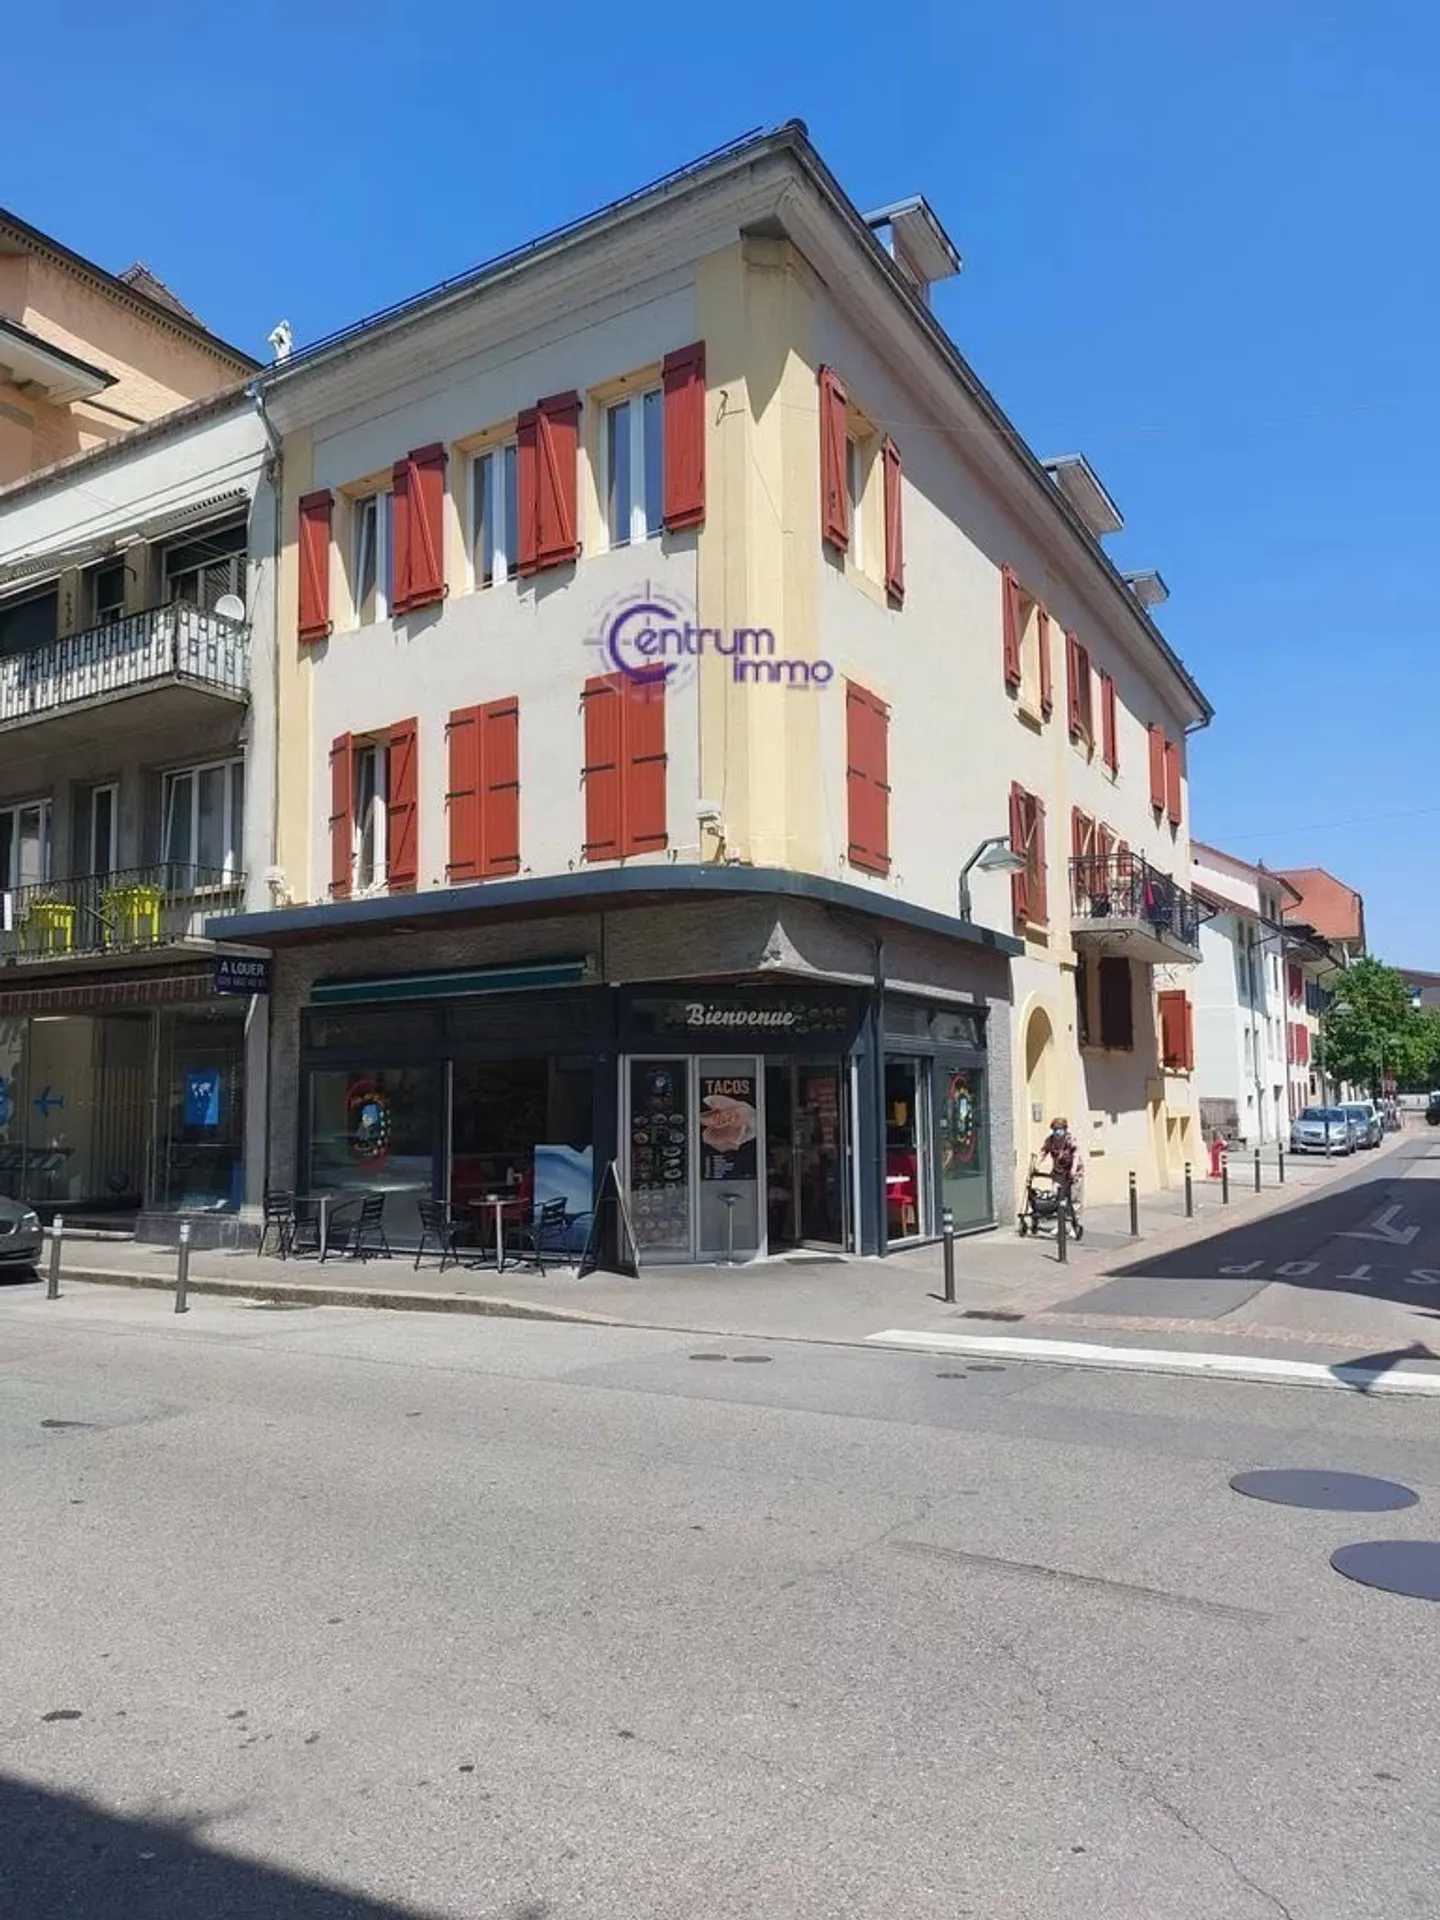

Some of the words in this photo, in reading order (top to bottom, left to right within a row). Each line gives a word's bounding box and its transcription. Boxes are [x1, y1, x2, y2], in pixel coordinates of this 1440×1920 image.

[220, 961, 229, 974] A
[231, 962, 265, 977] LOUER
[685, 1003, 796, 1027] Bienvenue
[705, 1079, 750, 1095] TACOS
